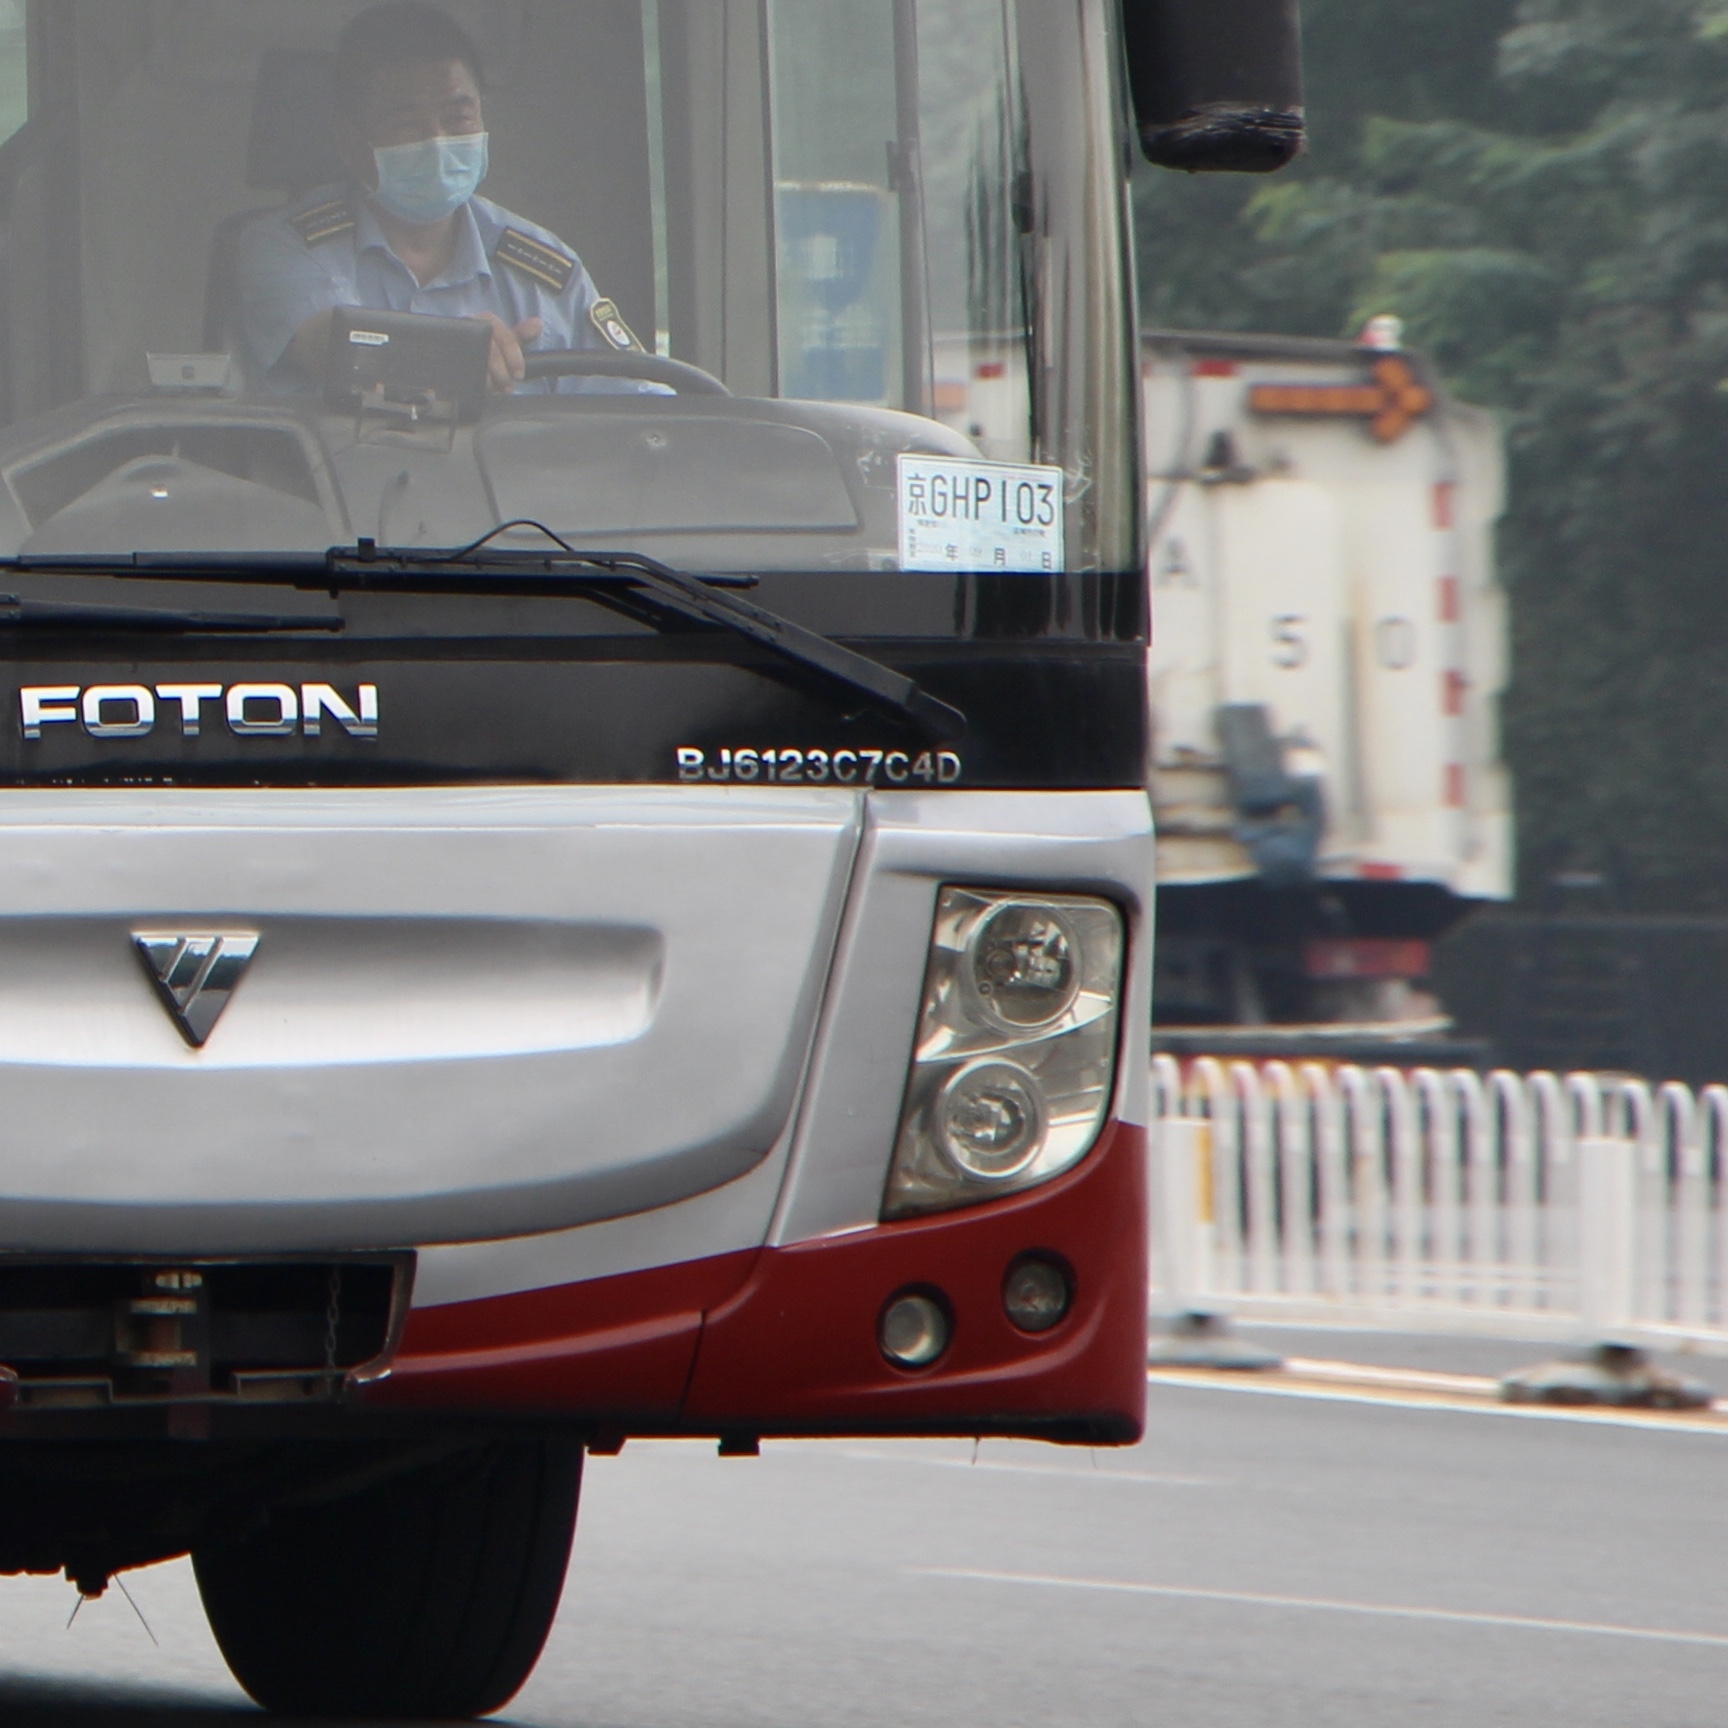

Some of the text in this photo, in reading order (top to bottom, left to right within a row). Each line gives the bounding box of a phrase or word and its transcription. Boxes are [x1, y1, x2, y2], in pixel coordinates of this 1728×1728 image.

[906, 473, 1055, 526] 京GHP103
[19, 683, 378, 741] FOTON
[676, 747, 962, 783] BJ6123C7C4D
